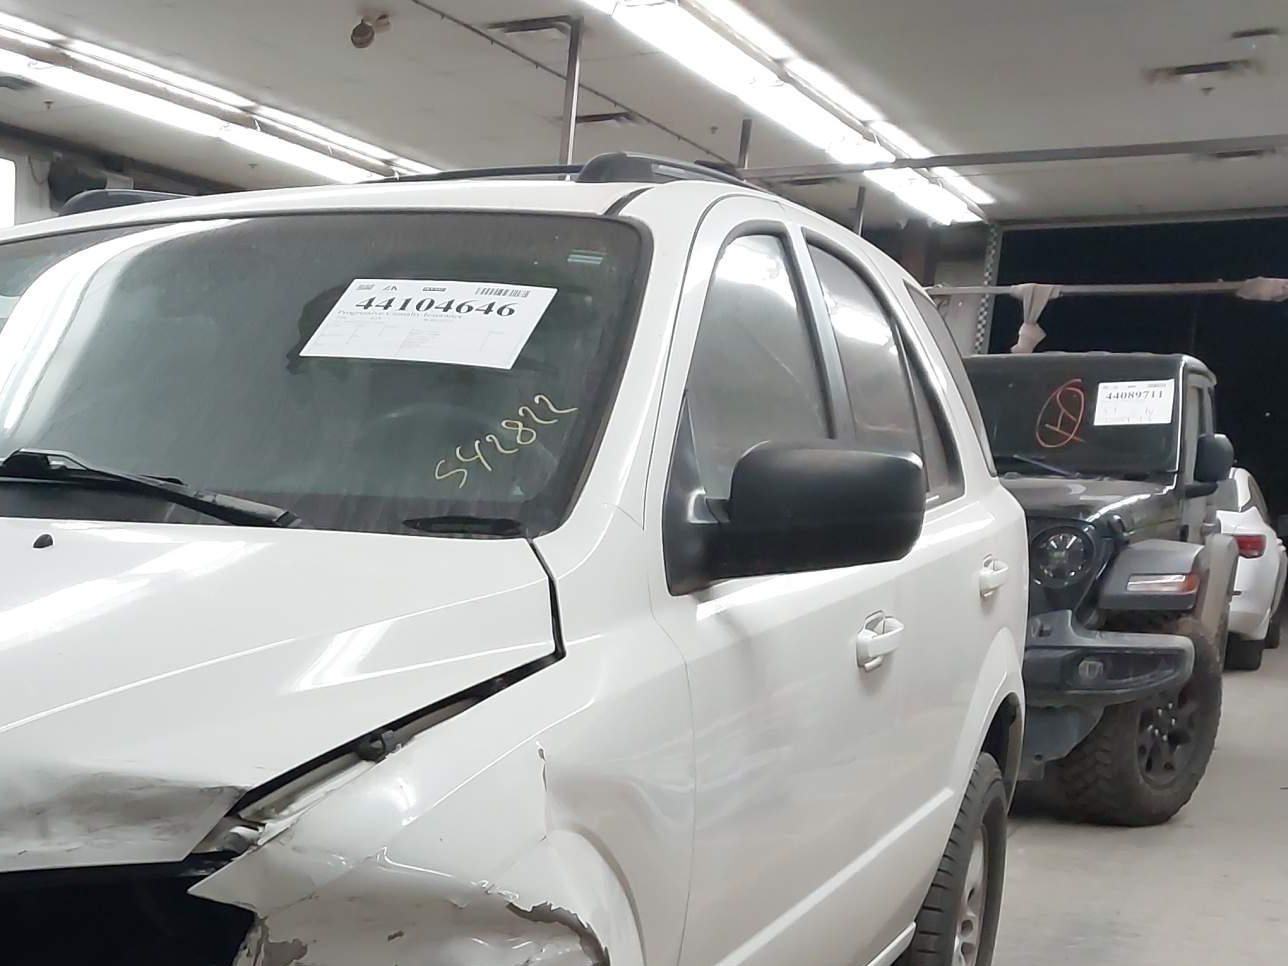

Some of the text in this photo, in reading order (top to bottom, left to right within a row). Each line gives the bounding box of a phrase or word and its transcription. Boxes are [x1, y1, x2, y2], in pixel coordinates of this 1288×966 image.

[355, 296, 517, 316] 44104646
[1105, 390, 1163, 400] 44089711
[434, 394, 579, 489] 542822
